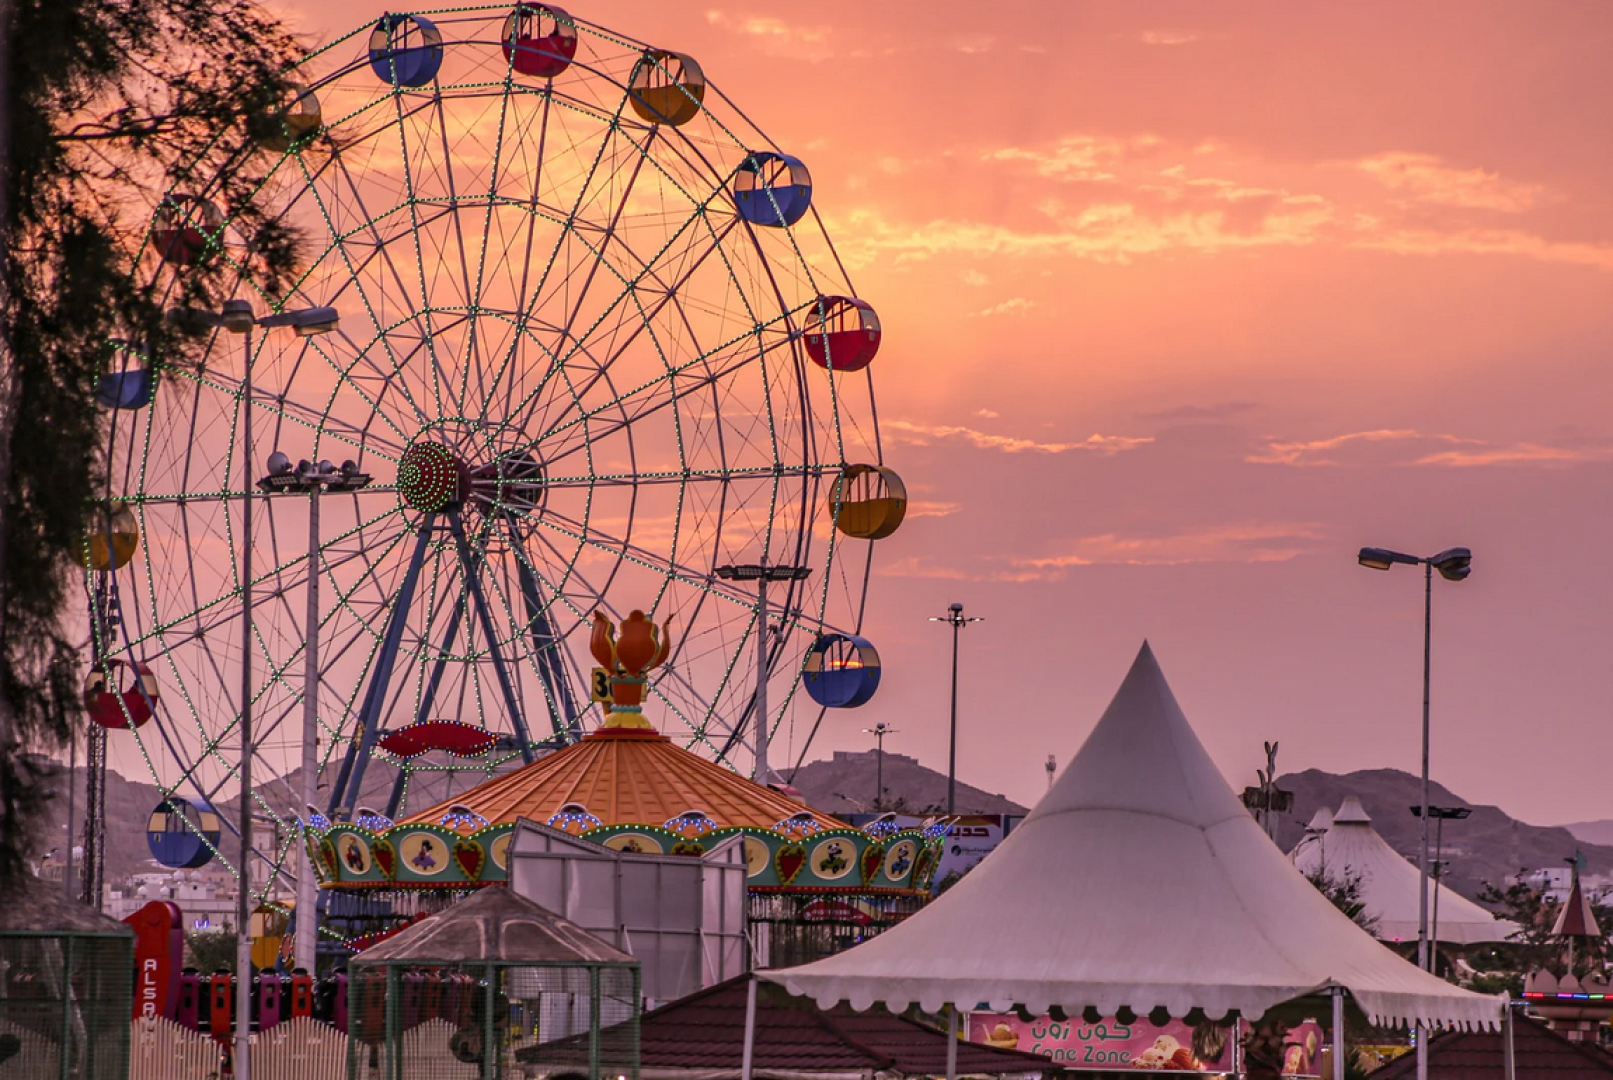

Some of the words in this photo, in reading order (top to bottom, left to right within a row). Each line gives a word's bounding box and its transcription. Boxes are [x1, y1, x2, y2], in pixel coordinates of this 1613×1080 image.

[594, 671, 614, 698] 3
[1031, 1021, 1071, 1040] زون
[1077, 1021, 1132, 1041] كون
[1083, 1045, 1131, 1064] Zone
